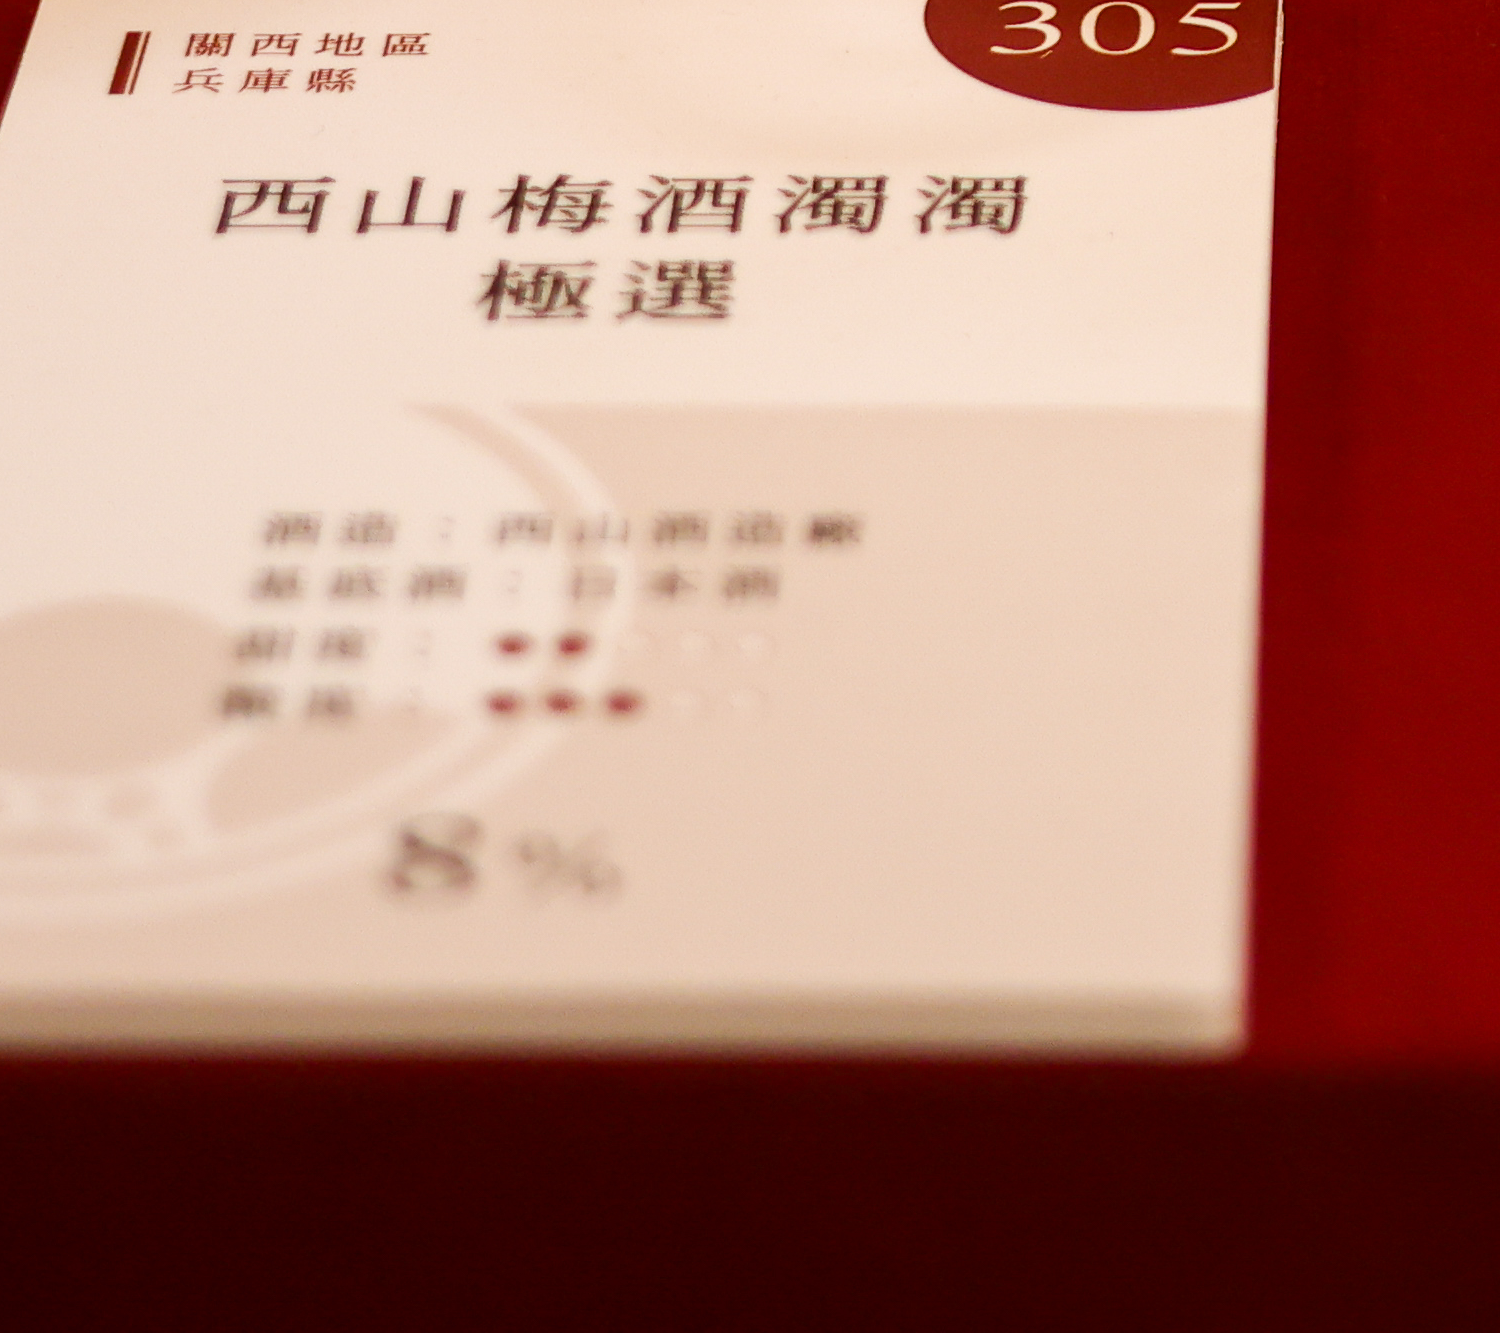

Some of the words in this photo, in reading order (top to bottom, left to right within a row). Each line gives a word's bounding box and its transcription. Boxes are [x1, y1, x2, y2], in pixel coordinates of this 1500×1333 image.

[183, 31, 433, 59] 關西地區
[989, 0, 1242, 58] 305
[172, 66, 358, 95] 兵庫縣
[214, 173, 1030, 237] 西山梅酒濁濁
[477, 259, 738, 323] 極選
